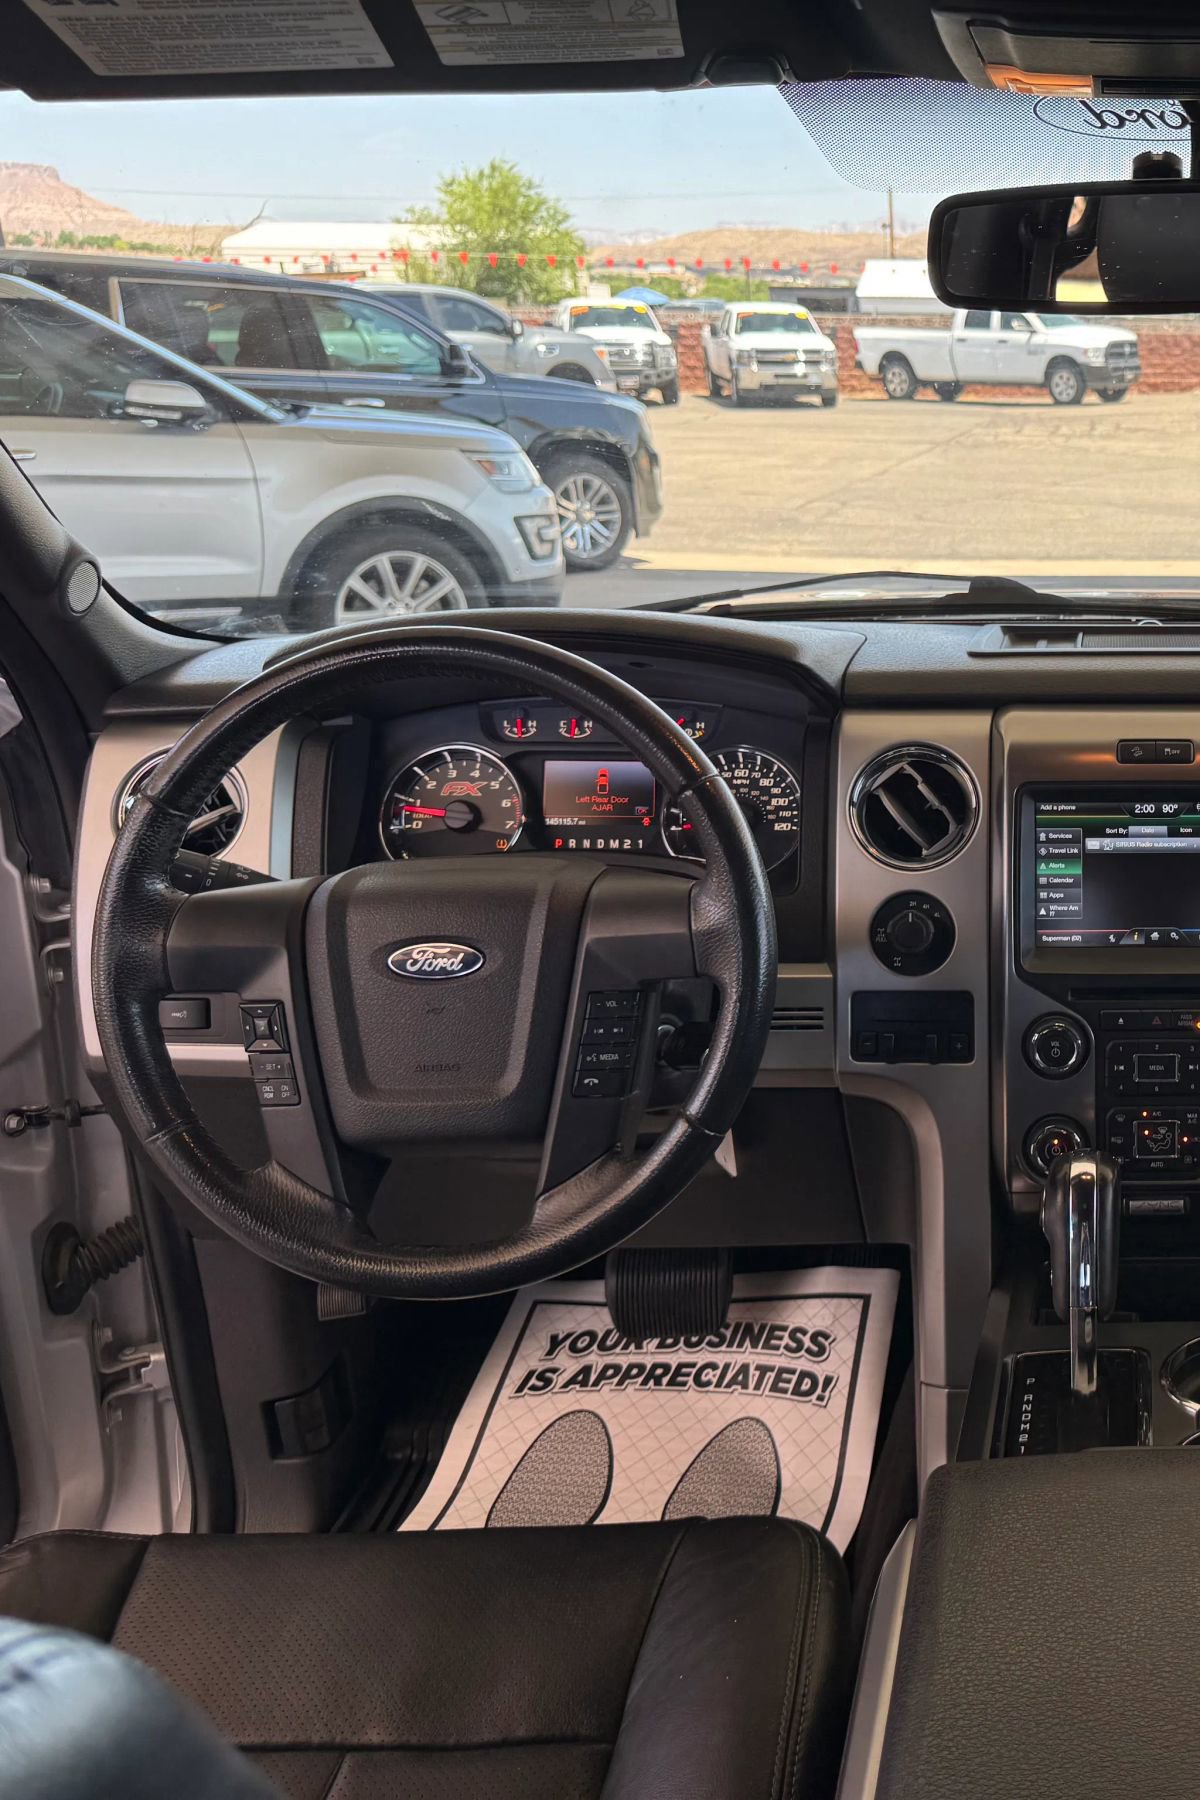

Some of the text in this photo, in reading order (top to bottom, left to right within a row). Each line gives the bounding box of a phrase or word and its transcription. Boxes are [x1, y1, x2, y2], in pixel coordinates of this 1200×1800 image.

[447, 770, 456, 778] 3
[470, 770, 480, 778] 4
[734, 769, 749, 777] 60
[426, 781, 437, 789] 2
[490, 781, 499, 789] 5
[759, 778, 774, 786] 80
[440, 781, 488, 796] FX
[575, 796, 629, 804] Left Rear Door
[771, 798, 788, 806] 100
[1058, 804, 1076, 812] phone
[1134, 804, 1155, 814] 2:00
[412, 821, 422, 829] 0
[505, 821, 514, 829] 7
[774, 823, 791, 831] 120
[555, 839, 643, 848] P R N D M 2 1
[406, 947, 465, 972] Ford
[514, 1361, 838, 1402] IS APPRECIATED!
[1026, 1377, 1035, 1385] P
[1021, 1413, 1031, 1421] D
[1020, 1422, 1030, 1431] M
